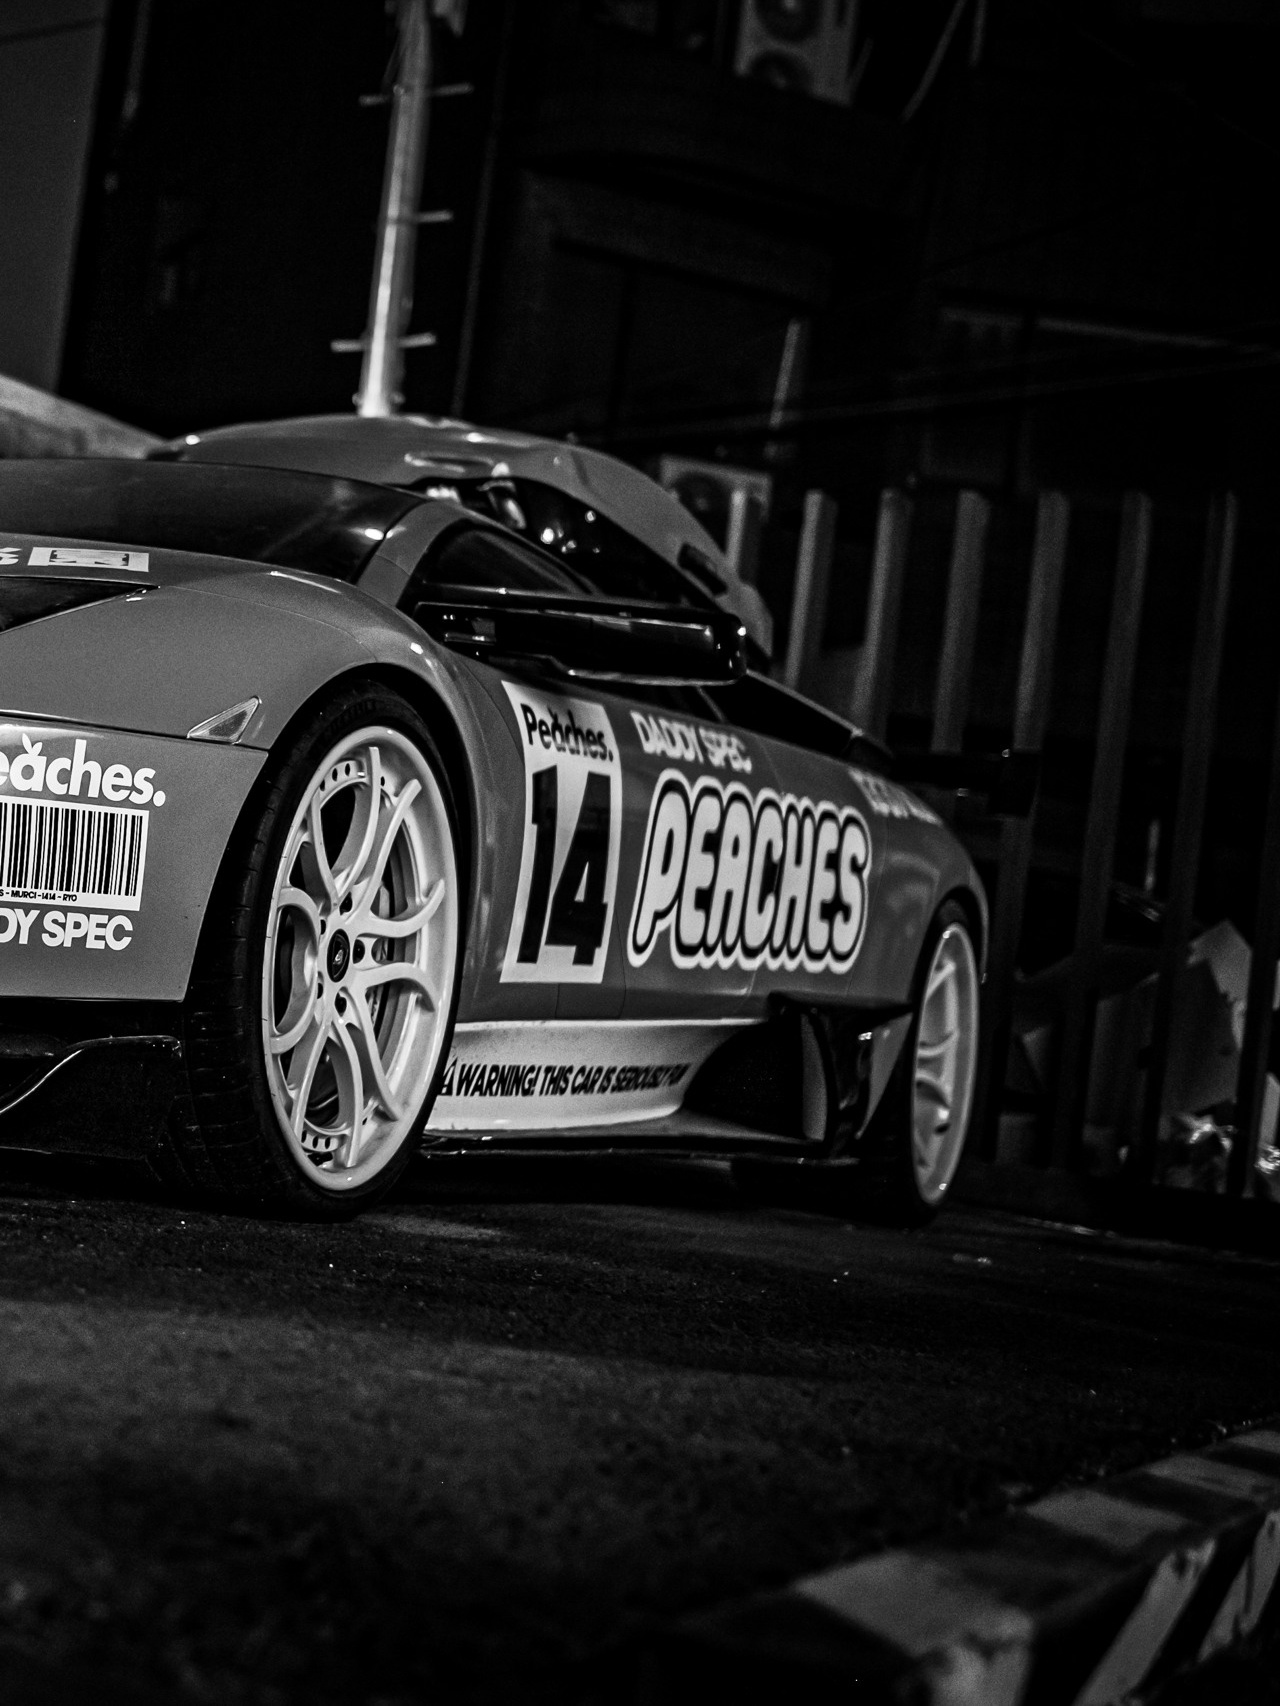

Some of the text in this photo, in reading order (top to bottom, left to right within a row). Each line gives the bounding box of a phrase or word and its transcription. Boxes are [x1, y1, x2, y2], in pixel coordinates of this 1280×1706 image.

[520, 703, 615, 763] Peaches.
[629, 709, 704, 765] DADDY
[516, 764, 611, 967] 14
[627, 767, 872, 975] PEACHES
[11, 890, 37, 899] MURCI
[41, 910, 134, 951] SPEC
[456, 1064, 542, 1097] WARNING!
[539, 1065, 574, 1096] THIS
[571, 1066, 604, 1095] CAR
[596, 1065, 618, 1094] IS
